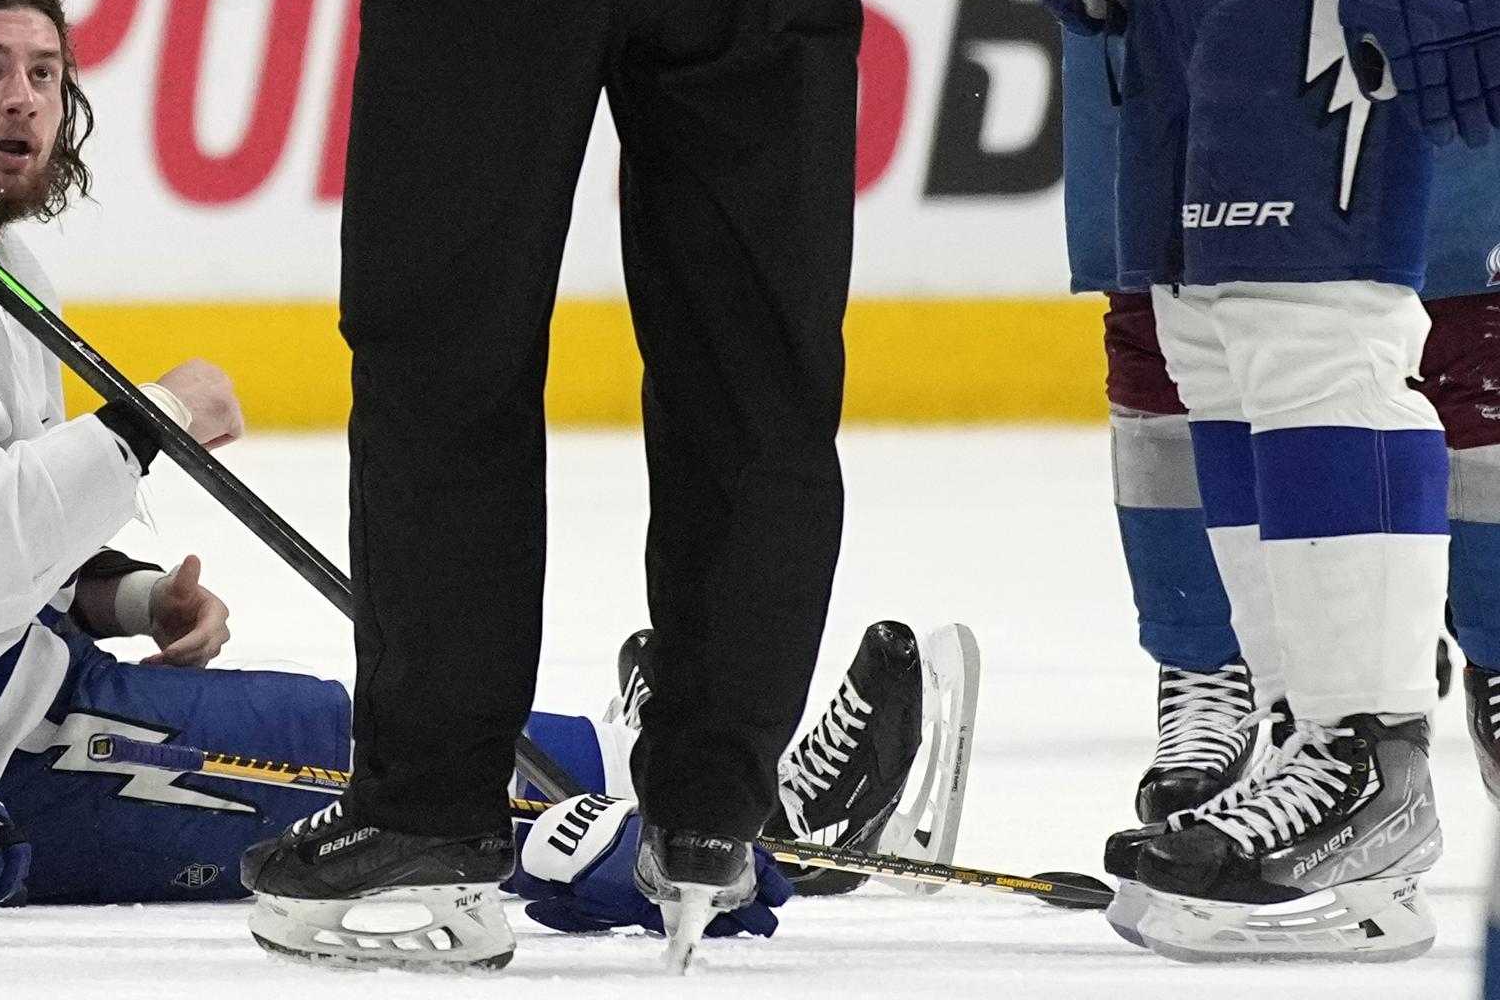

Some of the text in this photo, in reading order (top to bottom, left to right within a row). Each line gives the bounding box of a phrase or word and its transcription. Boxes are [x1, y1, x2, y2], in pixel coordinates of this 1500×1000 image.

[1182, 201, 1295, 229] AUER
[318, 826, 381, 857] BAUER
[1292, 825, 1355, 880] BAUER
[1312, 792, 1432, 889] VAPOR
[995, 876, 1053, 892] SHERWOOD
